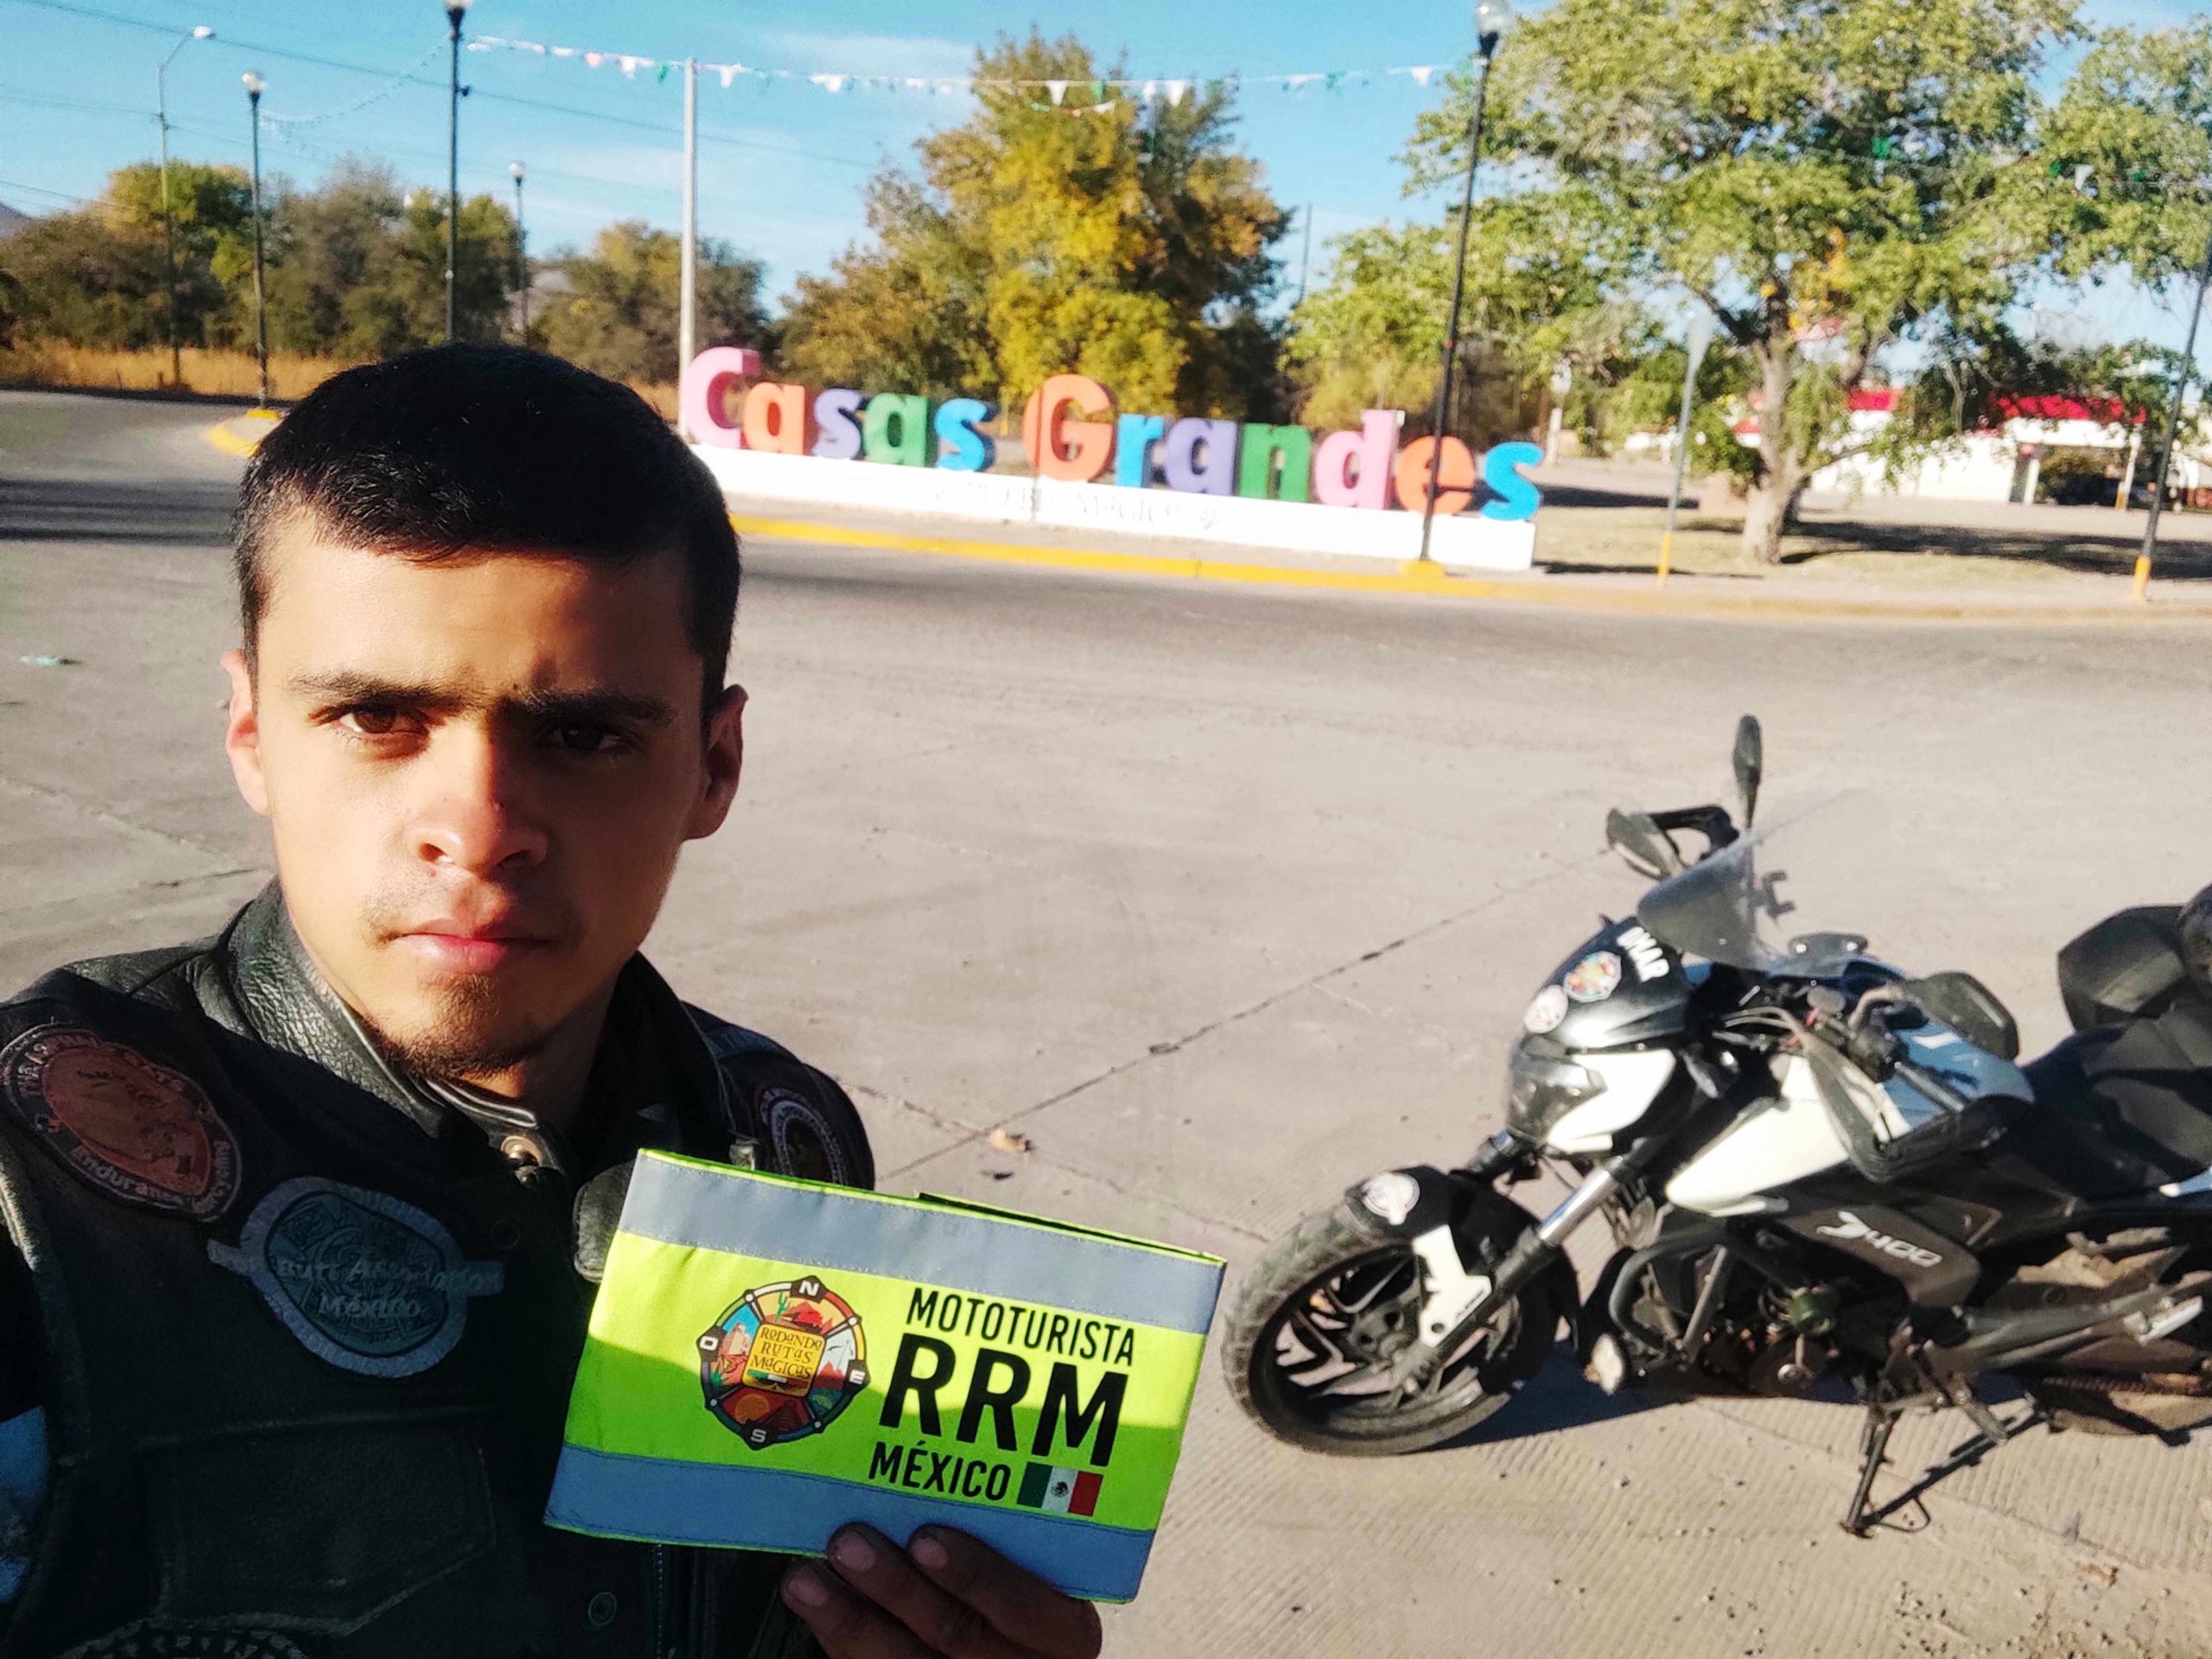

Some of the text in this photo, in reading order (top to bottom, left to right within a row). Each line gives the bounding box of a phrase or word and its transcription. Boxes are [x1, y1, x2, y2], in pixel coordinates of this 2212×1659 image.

[687, 346, 1544, 521] Casas Grandes
[798, 1280, 820, 1296] N
[699, 1335, 719, 1351] O
[906, 1287, 1135, 1366] MOTOTURISTA
[849, 1370, 866, 1384] E
[879, 1332, 1128, 1467] RRM
[750, 1428, 767, 1443] S
[868, 1440, 1012, 1502] MÉXICO
